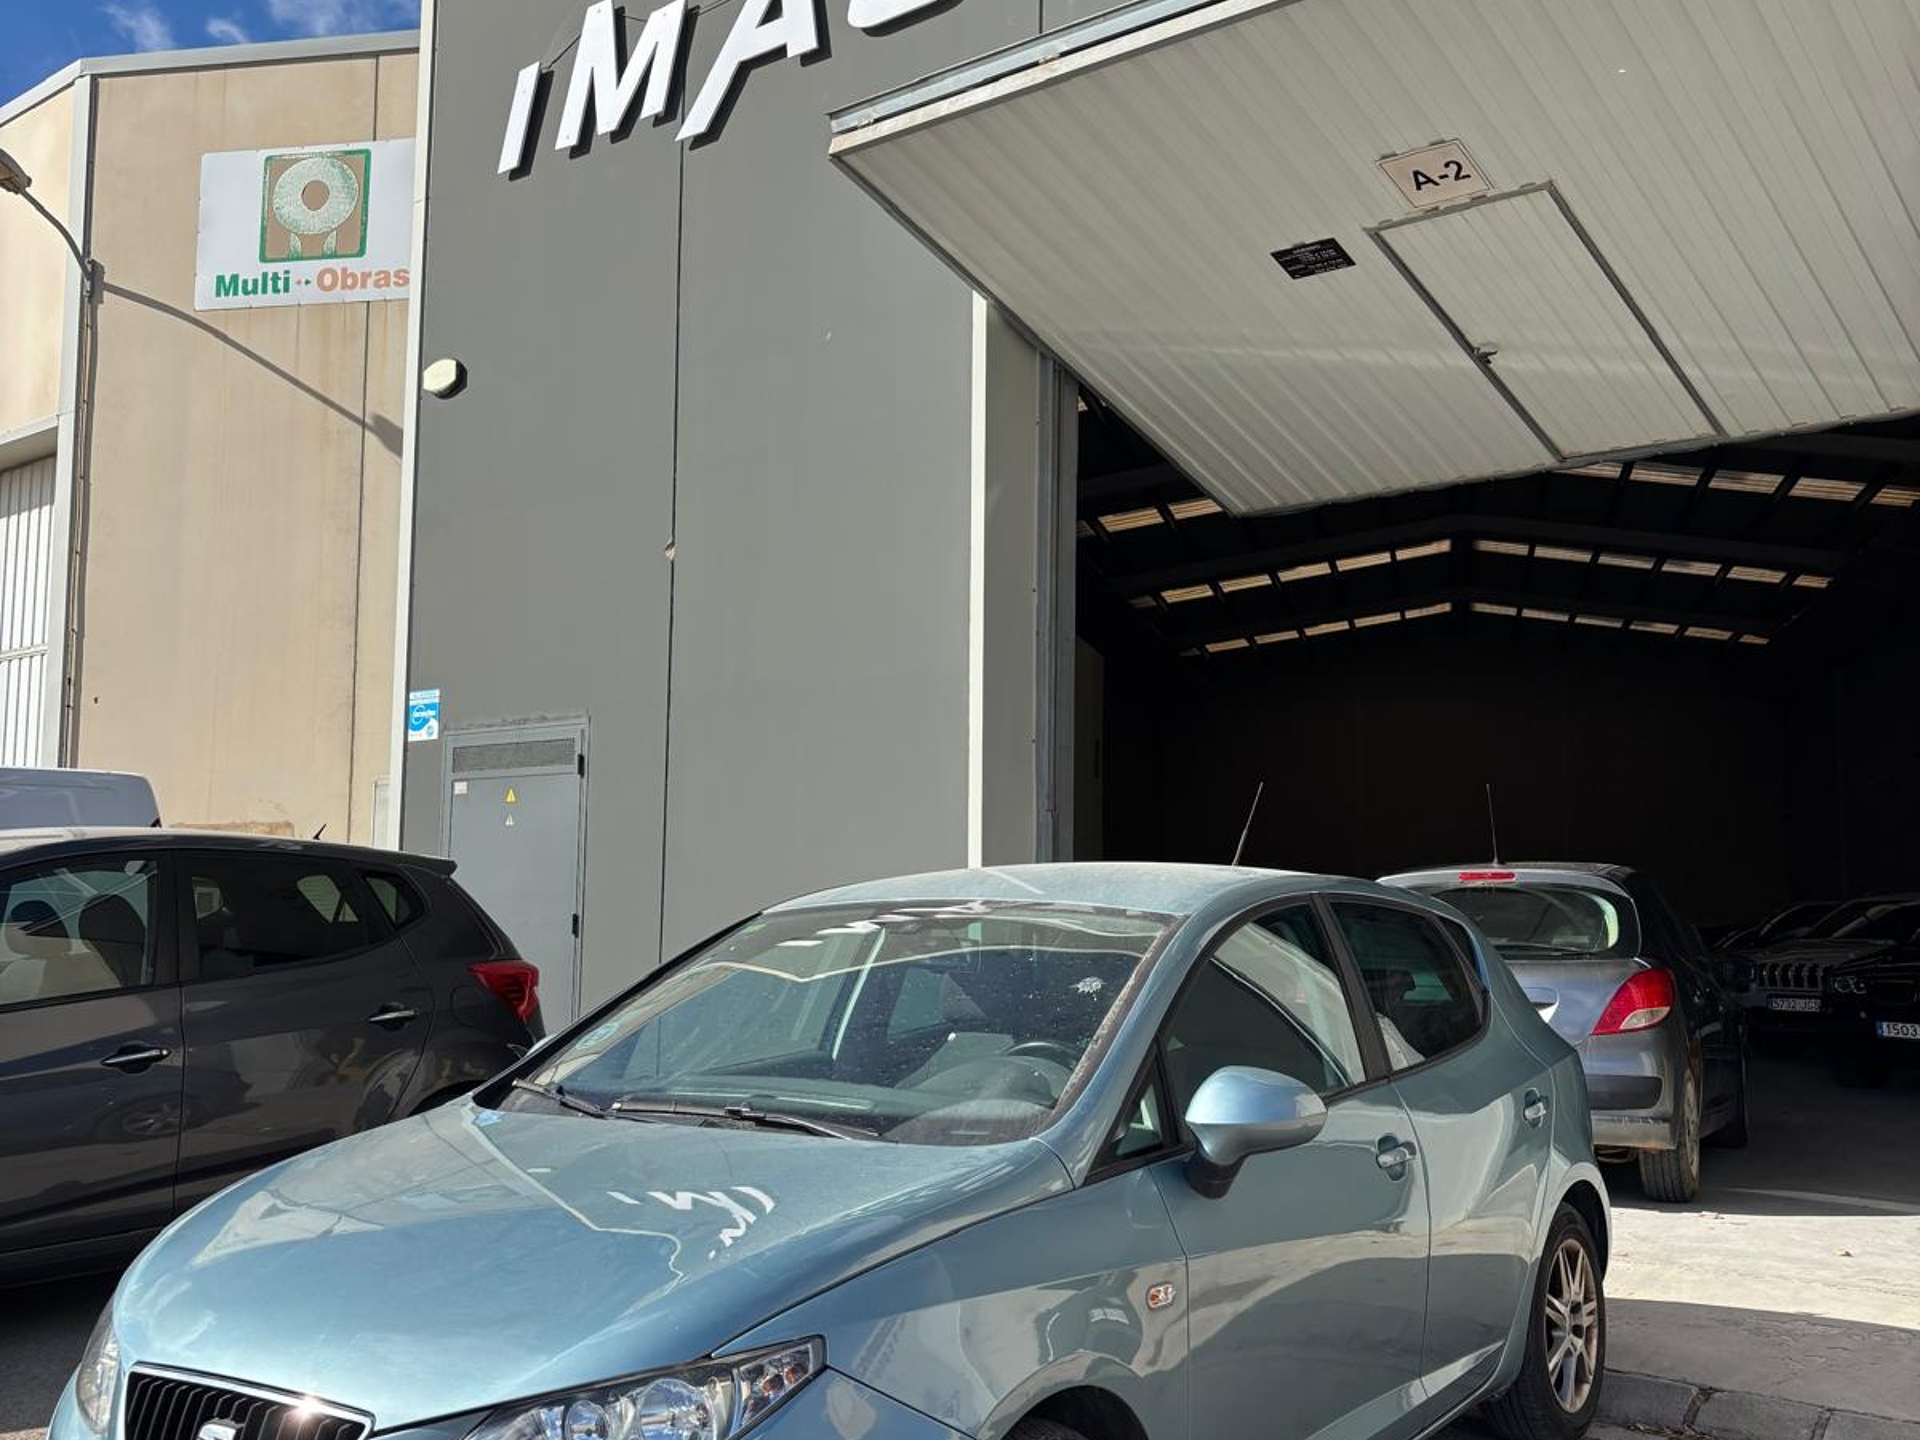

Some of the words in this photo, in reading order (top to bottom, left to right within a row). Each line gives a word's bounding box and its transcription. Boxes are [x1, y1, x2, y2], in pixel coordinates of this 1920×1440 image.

[498, 0, 943, 174] IMA
[1413, 160, 1471, 191] A-2
[215, 270, 290, 297] Multi
[317, 267, 410, 292] Obras
[1886, 1023, 1918, 1037] 1503
